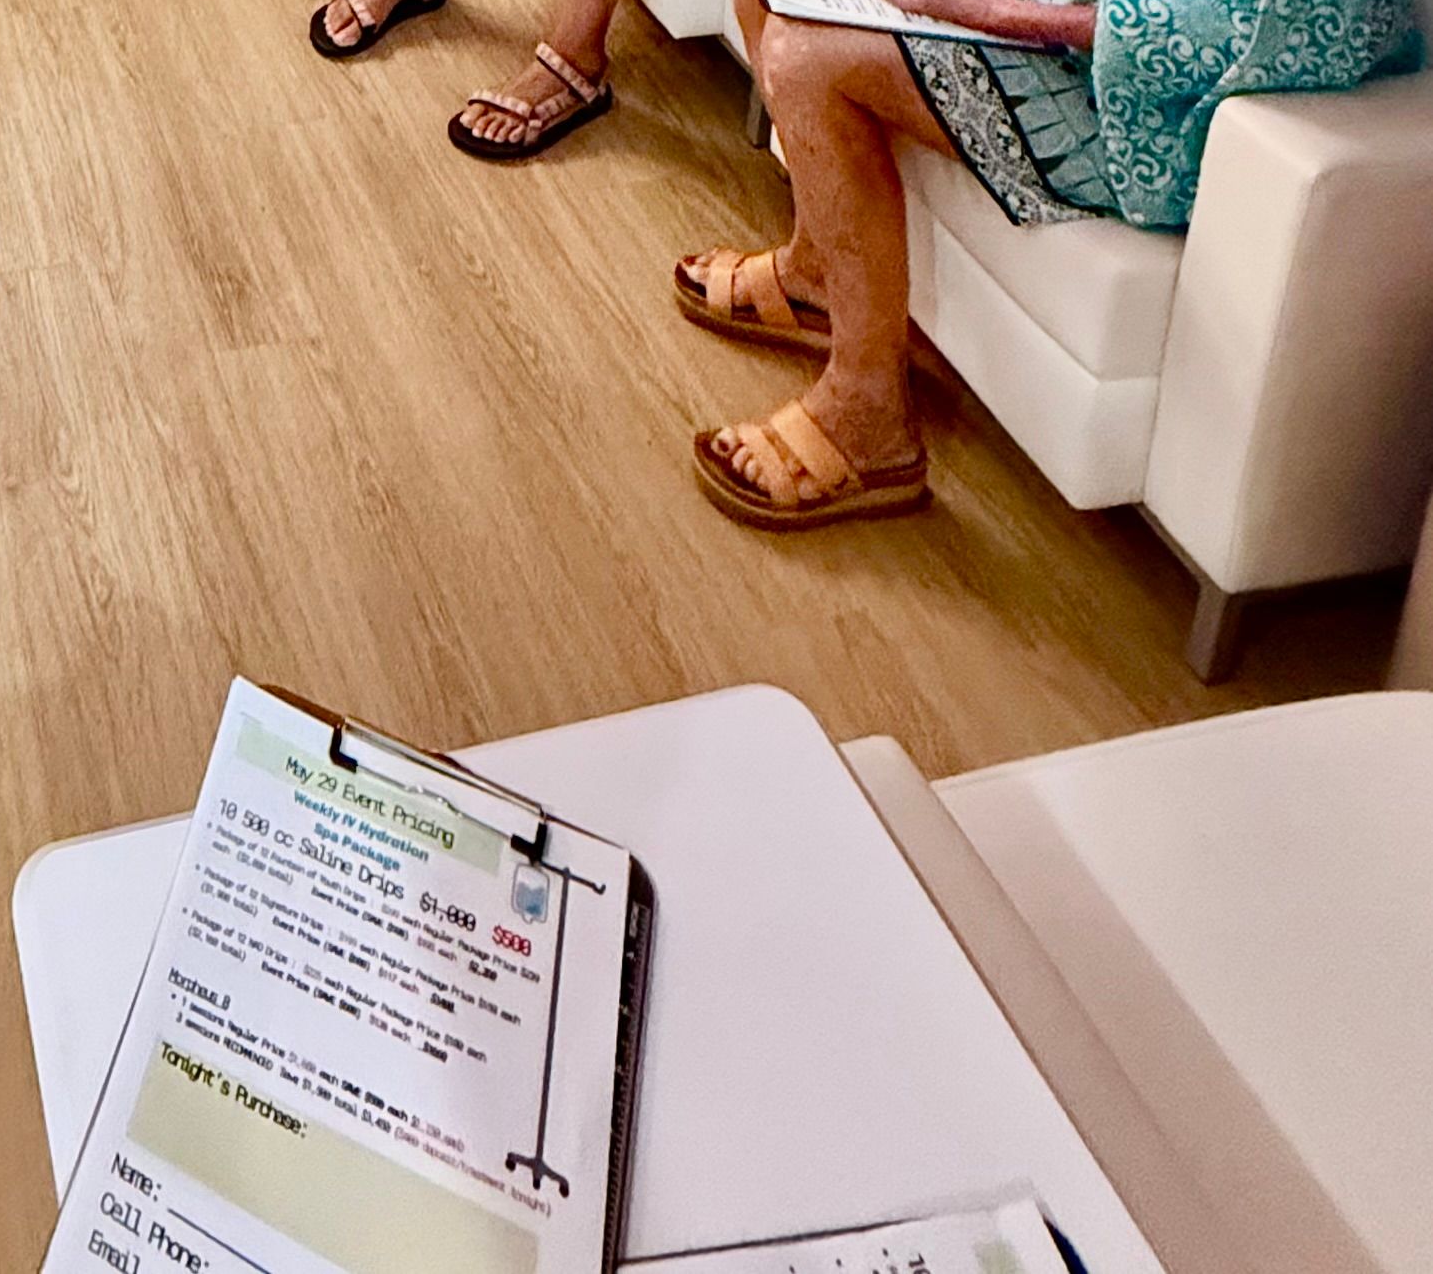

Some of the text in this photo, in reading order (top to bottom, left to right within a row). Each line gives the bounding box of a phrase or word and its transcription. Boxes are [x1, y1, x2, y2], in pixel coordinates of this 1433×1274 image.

[286, 756, 454, 850] May 29 Event Pricing
[294, 791, 429, 862] Weekly IV Hydration
[298, 837, 353, 875] Saline
[358, 864, 404, 899] Drips
[314, 822, 400, 871] Spa Package
[168, 967, 218, 1005] Morpheus
[162, 1042, 230, 1096] Tonight's
[235, 1084, 307, 1138] Purchase:
[111, 1153, 161, 1201] Name:
[100, 1192, 141, 1237] Cell
[88, 1229, 140, 1274] Email
